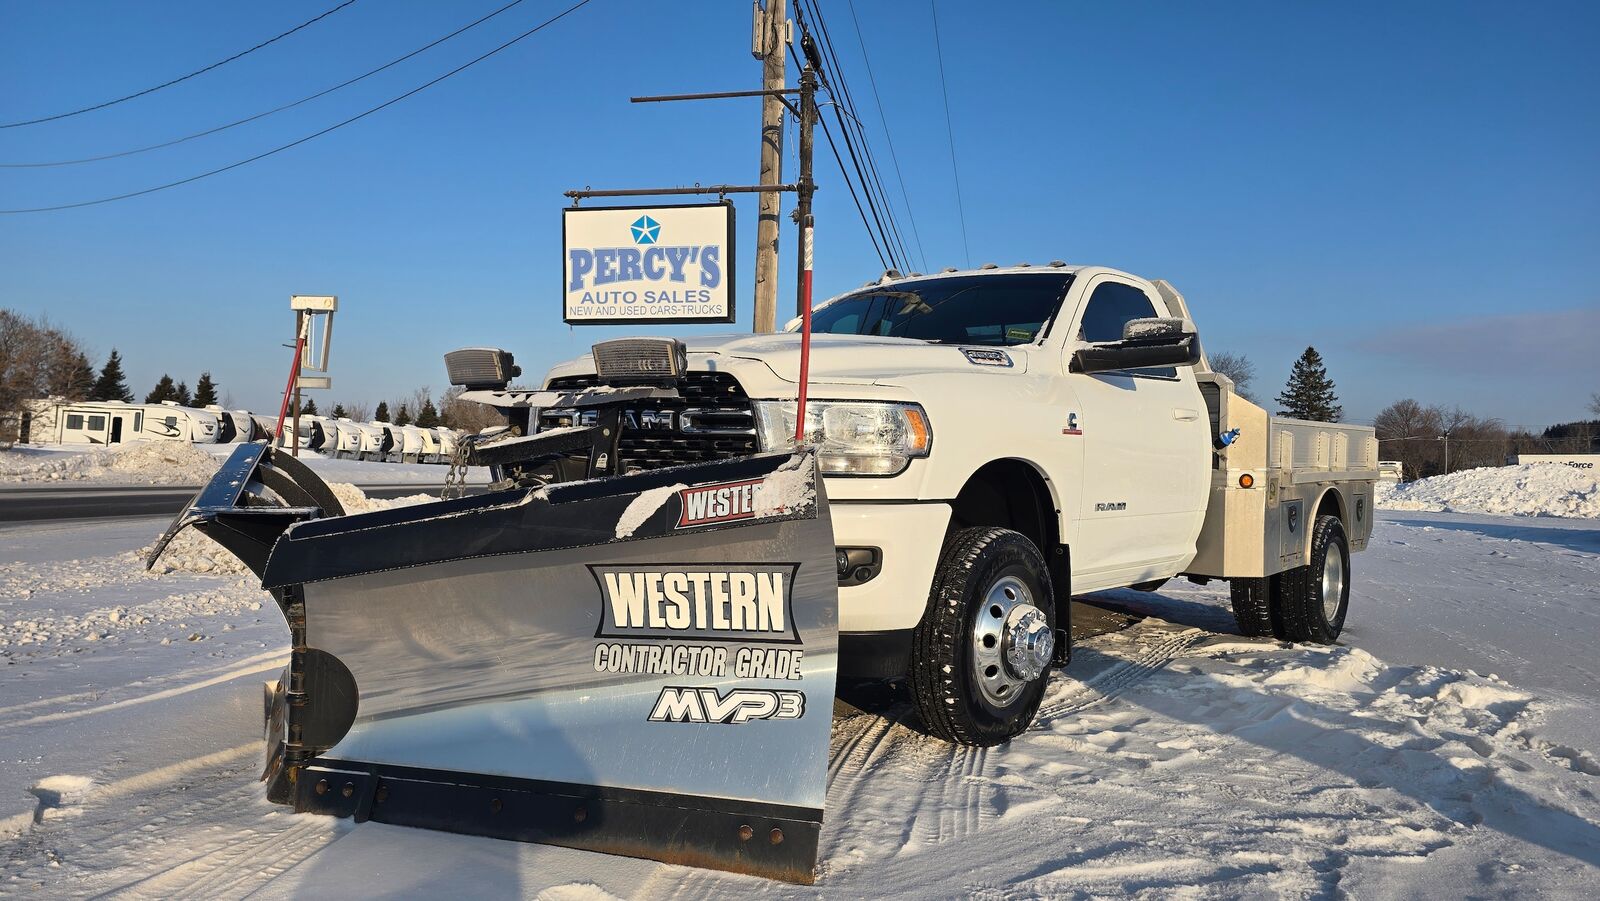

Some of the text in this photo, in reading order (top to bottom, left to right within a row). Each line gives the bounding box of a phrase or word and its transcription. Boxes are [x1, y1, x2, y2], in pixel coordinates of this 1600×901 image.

[569, 244, 721, 293] PERCY'S
[569, 304, 723, 316] NEW AND USED CARS-TRUCKS
[580, 290, 711, 304] AUTO SALES
[686, 483, 766, 522] WESTE
[1094, 502, 1127, 512] RAM
[603, 572, 785, 633] WESTERN
[593, 643, 804, 681] CONTRACTOR GRADE
[646, 685, 807, 724] MVP3
